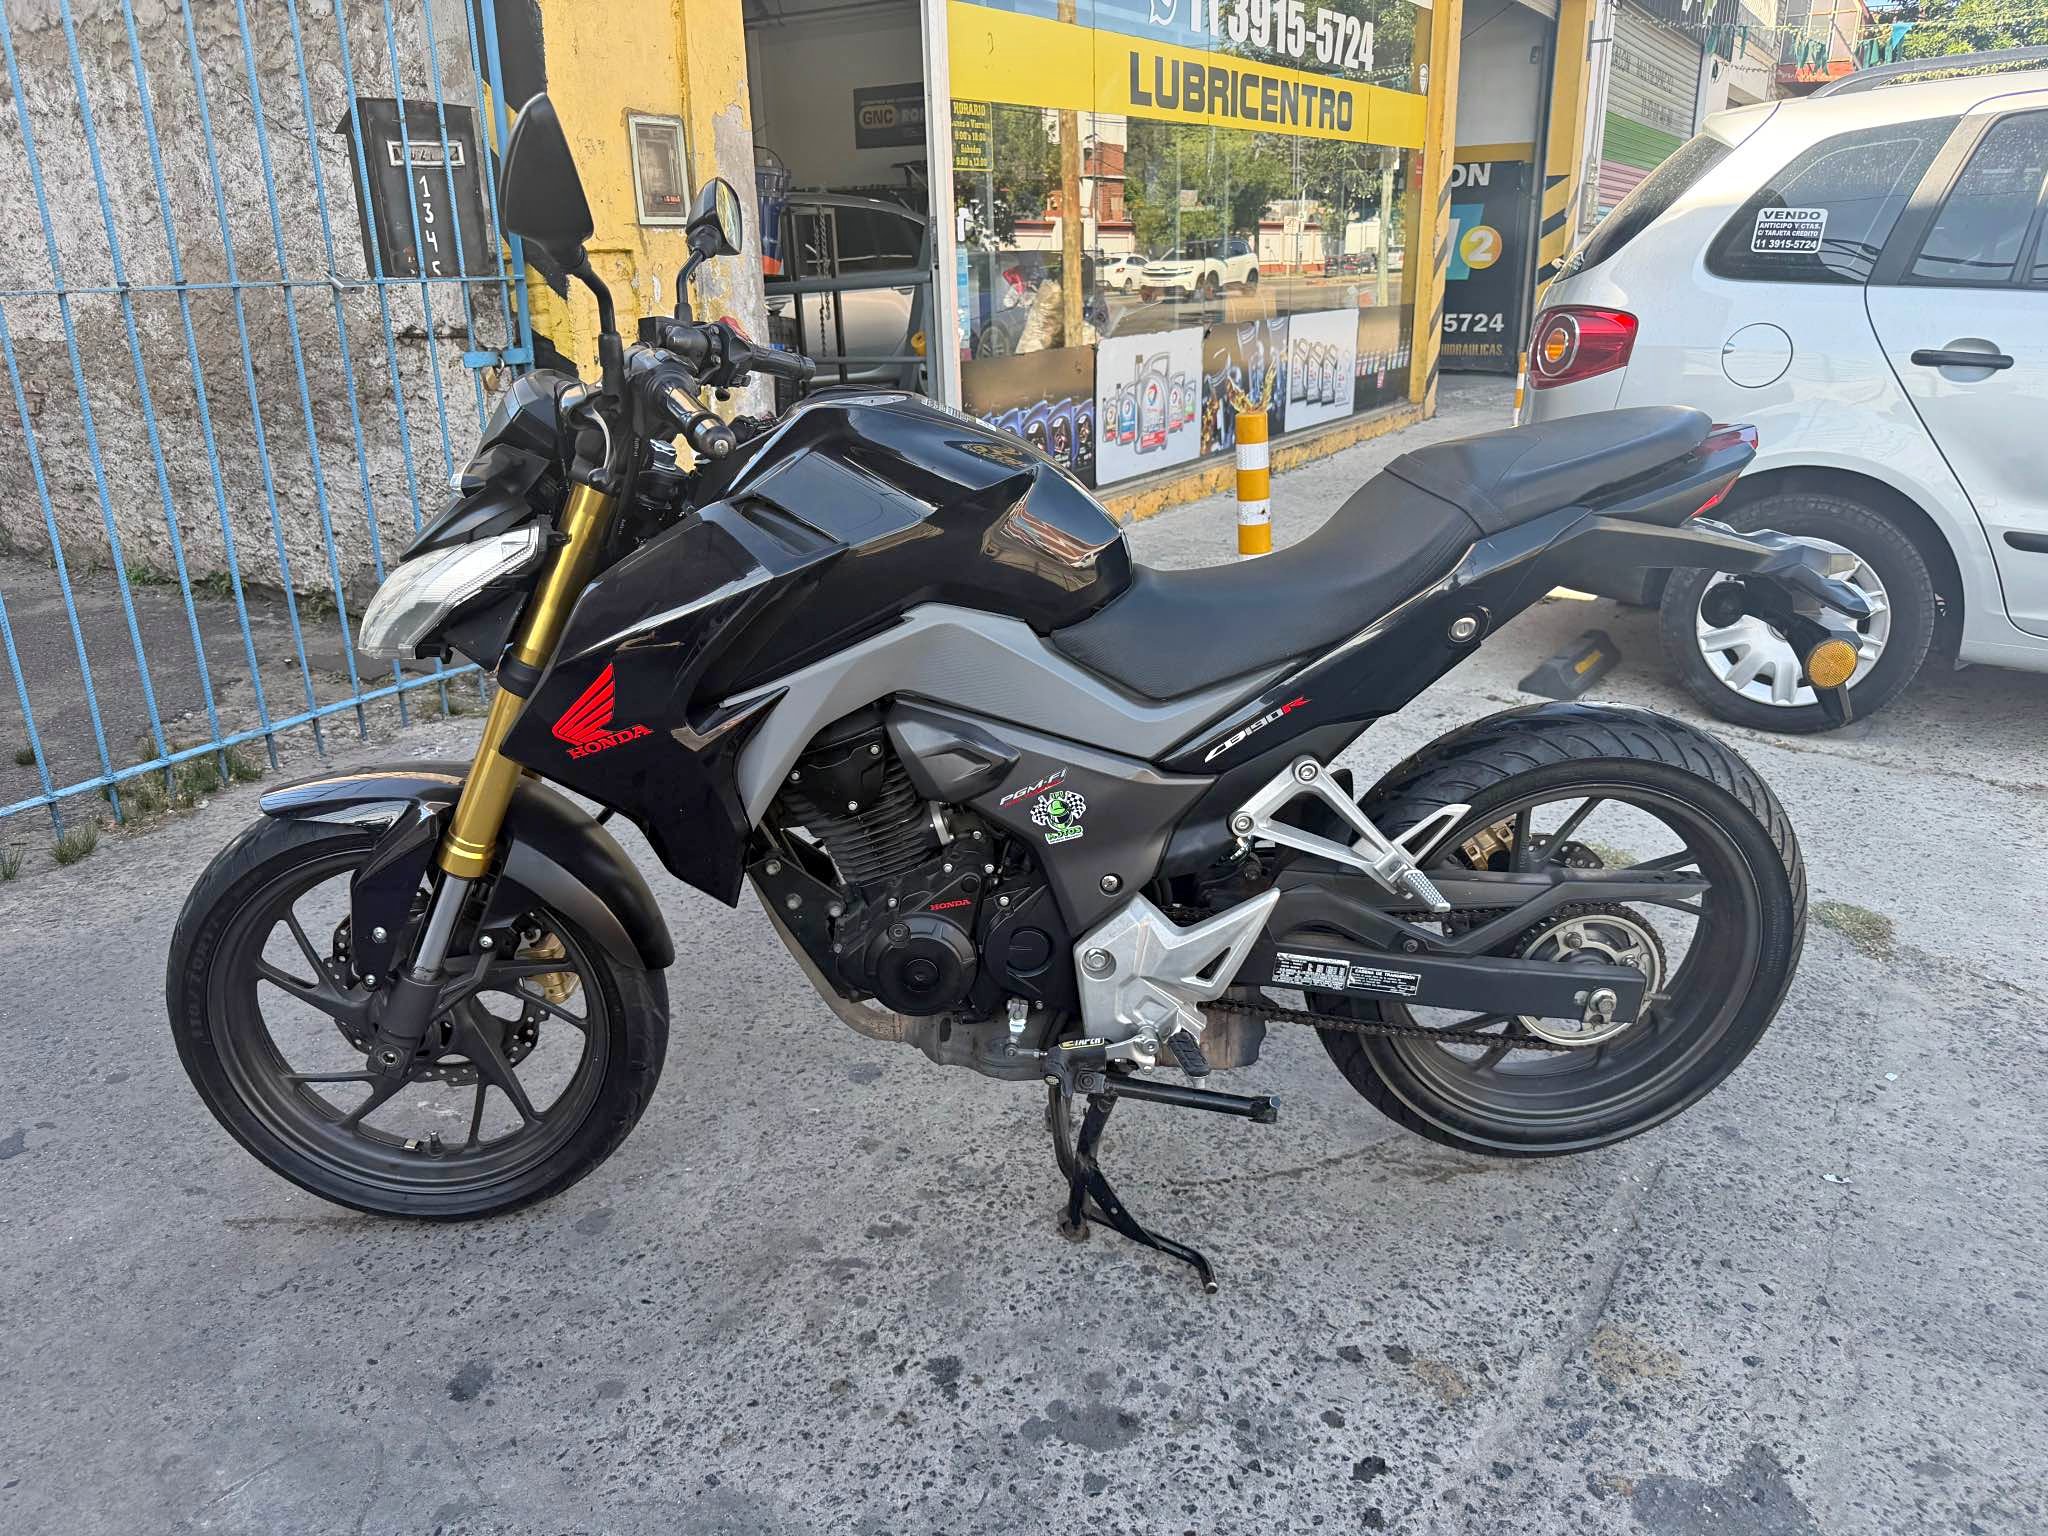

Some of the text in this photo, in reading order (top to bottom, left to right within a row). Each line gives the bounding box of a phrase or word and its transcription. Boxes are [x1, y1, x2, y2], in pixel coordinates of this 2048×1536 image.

[1227, 0, 1376, 72] 3915-5724
[1129, 50, 1353, 132] LUBRICENTRO
[863, 109, 893, 126] GNC
[953, 101, 986, 117] HORARIO
[1763, 210, 1821, 220] VENDO
[1755, 239, 1817, 249] 11 3915-5724
[1204, 697, 1311, 763] CB190R
[566, 724, 654, 760] HONDA
[930, 899, 972, 911] HONDA
